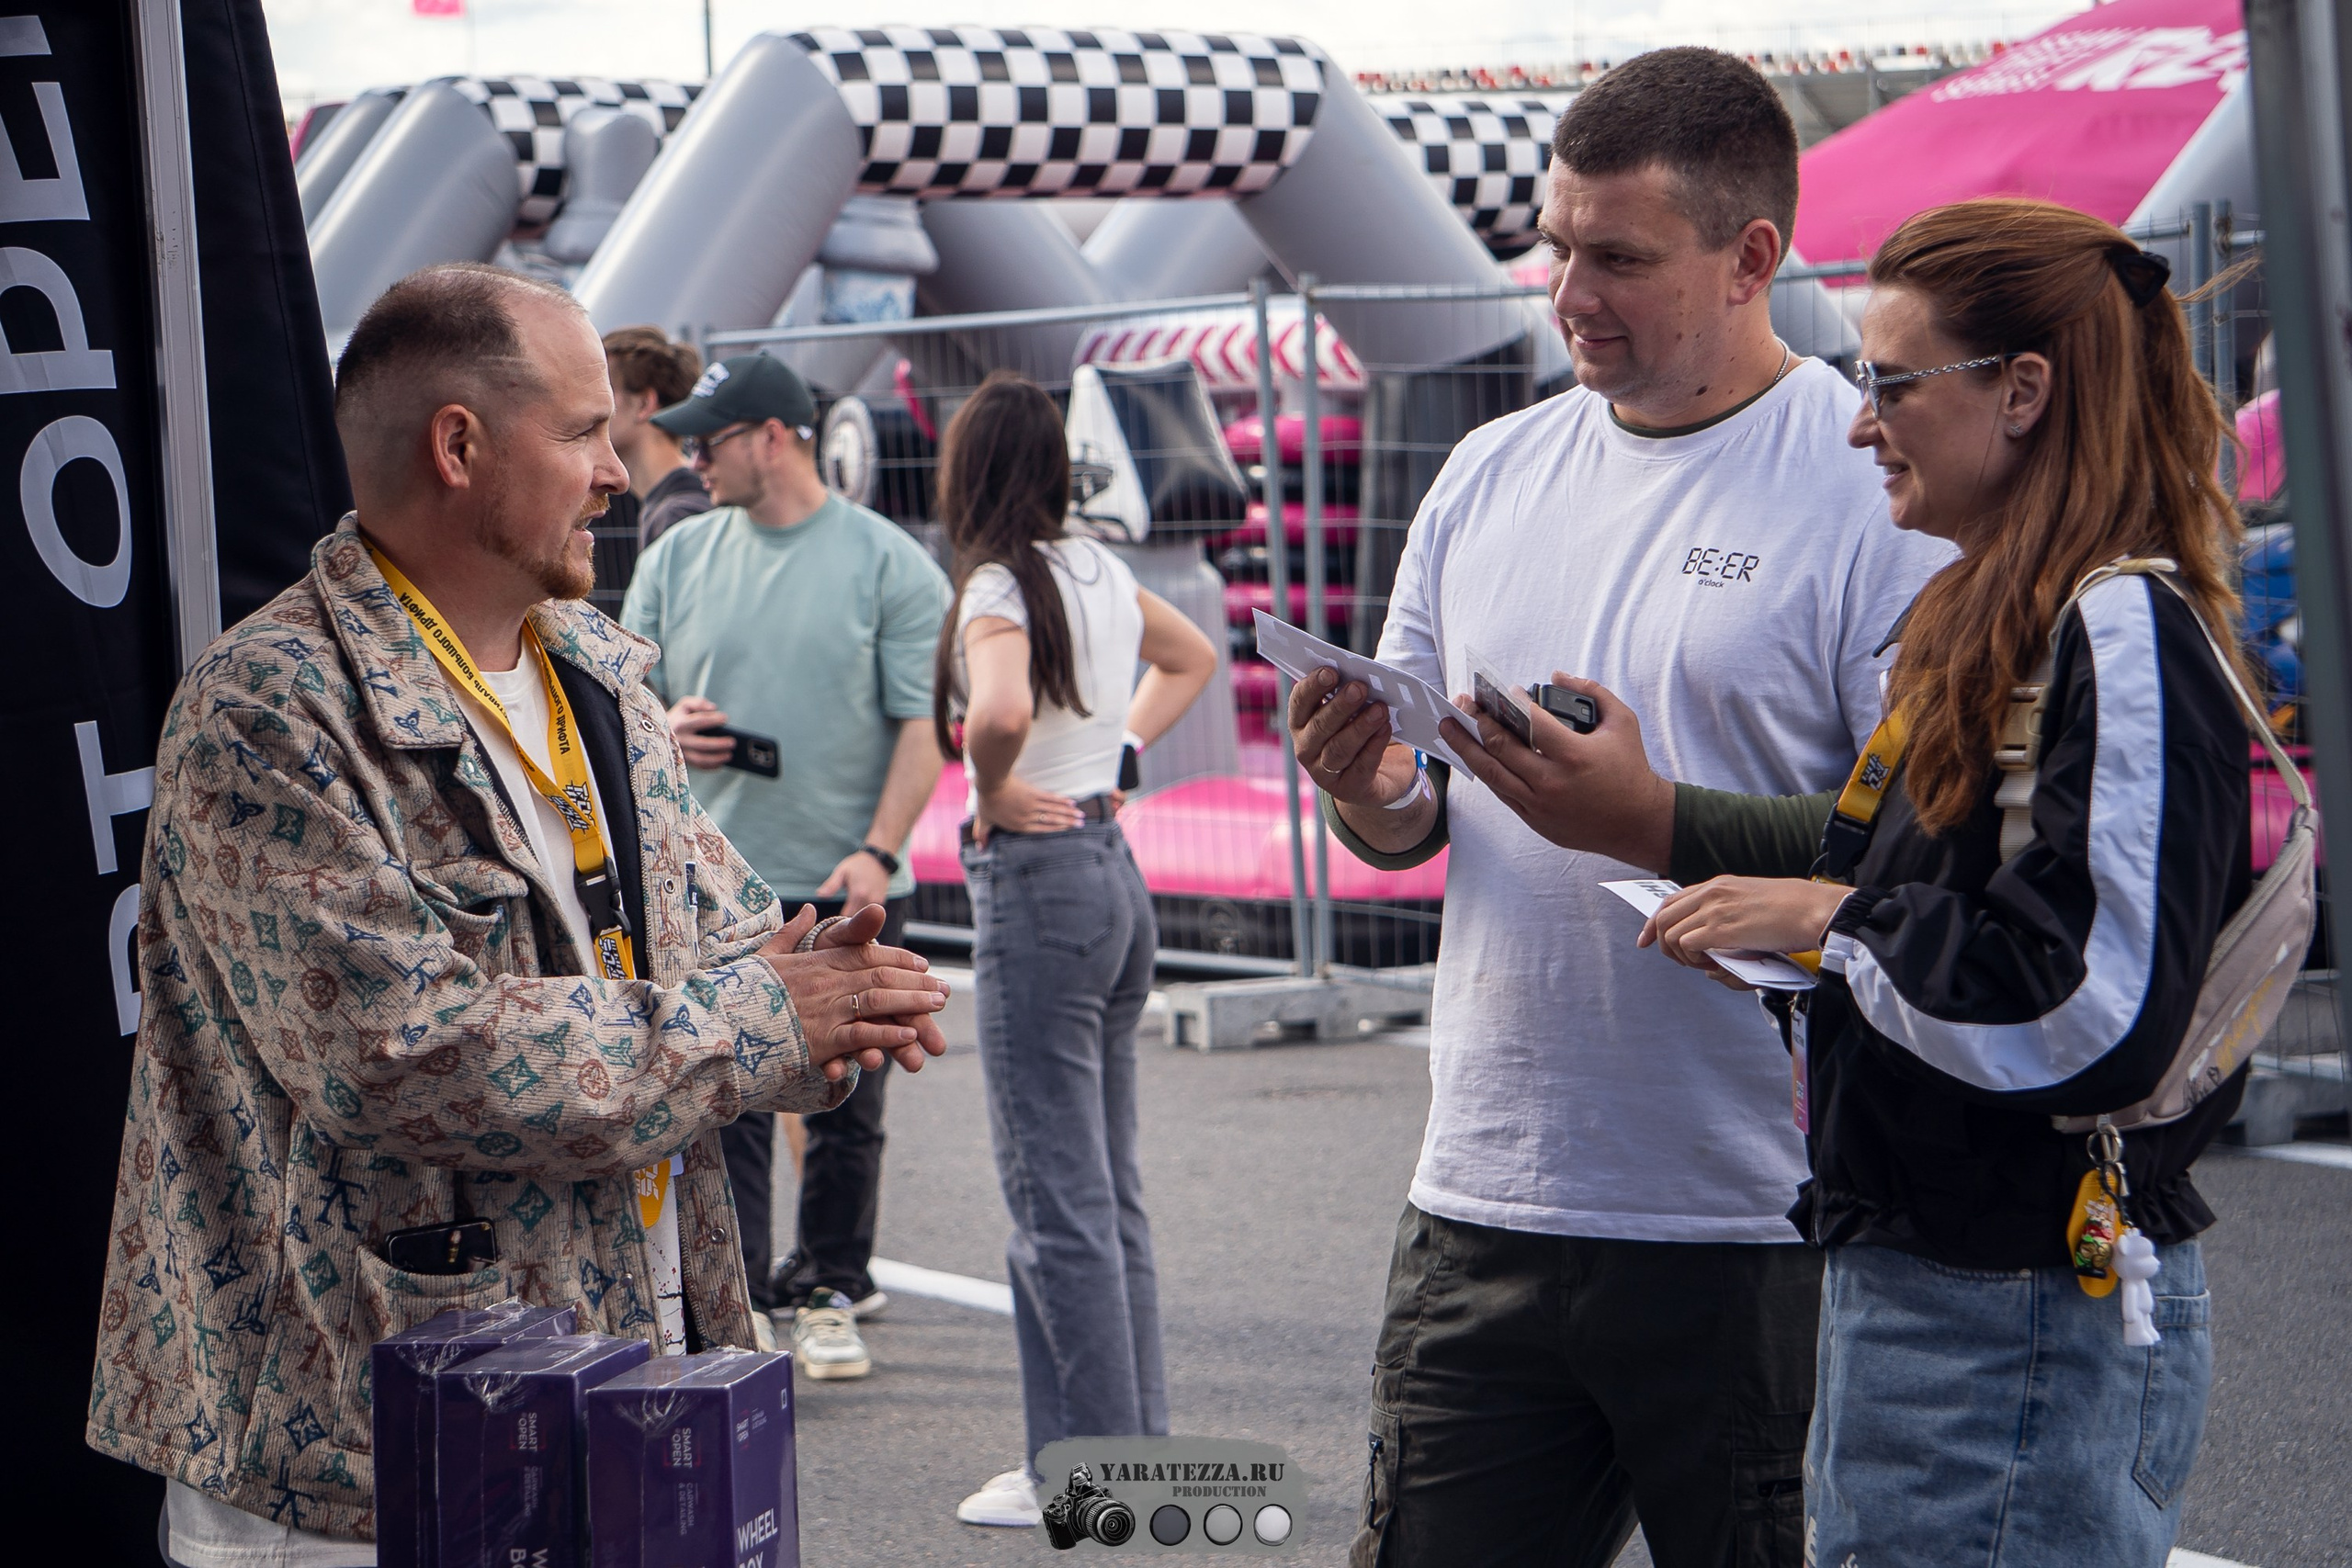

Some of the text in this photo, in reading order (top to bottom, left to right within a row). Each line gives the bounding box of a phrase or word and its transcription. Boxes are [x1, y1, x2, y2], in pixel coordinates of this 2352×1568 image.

[1681, 547, 1759, 582] BE:ER
[1698, 579, 1724, 588] o'clock
[399, 592, 438, 630] ДРИФТА
[432, 628, 474, 681] БОЛЬШОГО
[557, 714, 571, 755] ДРИФТА
[518, 1417, 528, 1450] OPEN
[528, 1412, 538, 1452] SMART
[673, 1433, 682, 1467] OPEN
[683, 1427, 693, 1468] SMART
[679, 1490, 687, 1536] DETAILING
[686, 1482, 695, 1527] CARWASH
[737, 1507, 779, 1553] WHEEL
